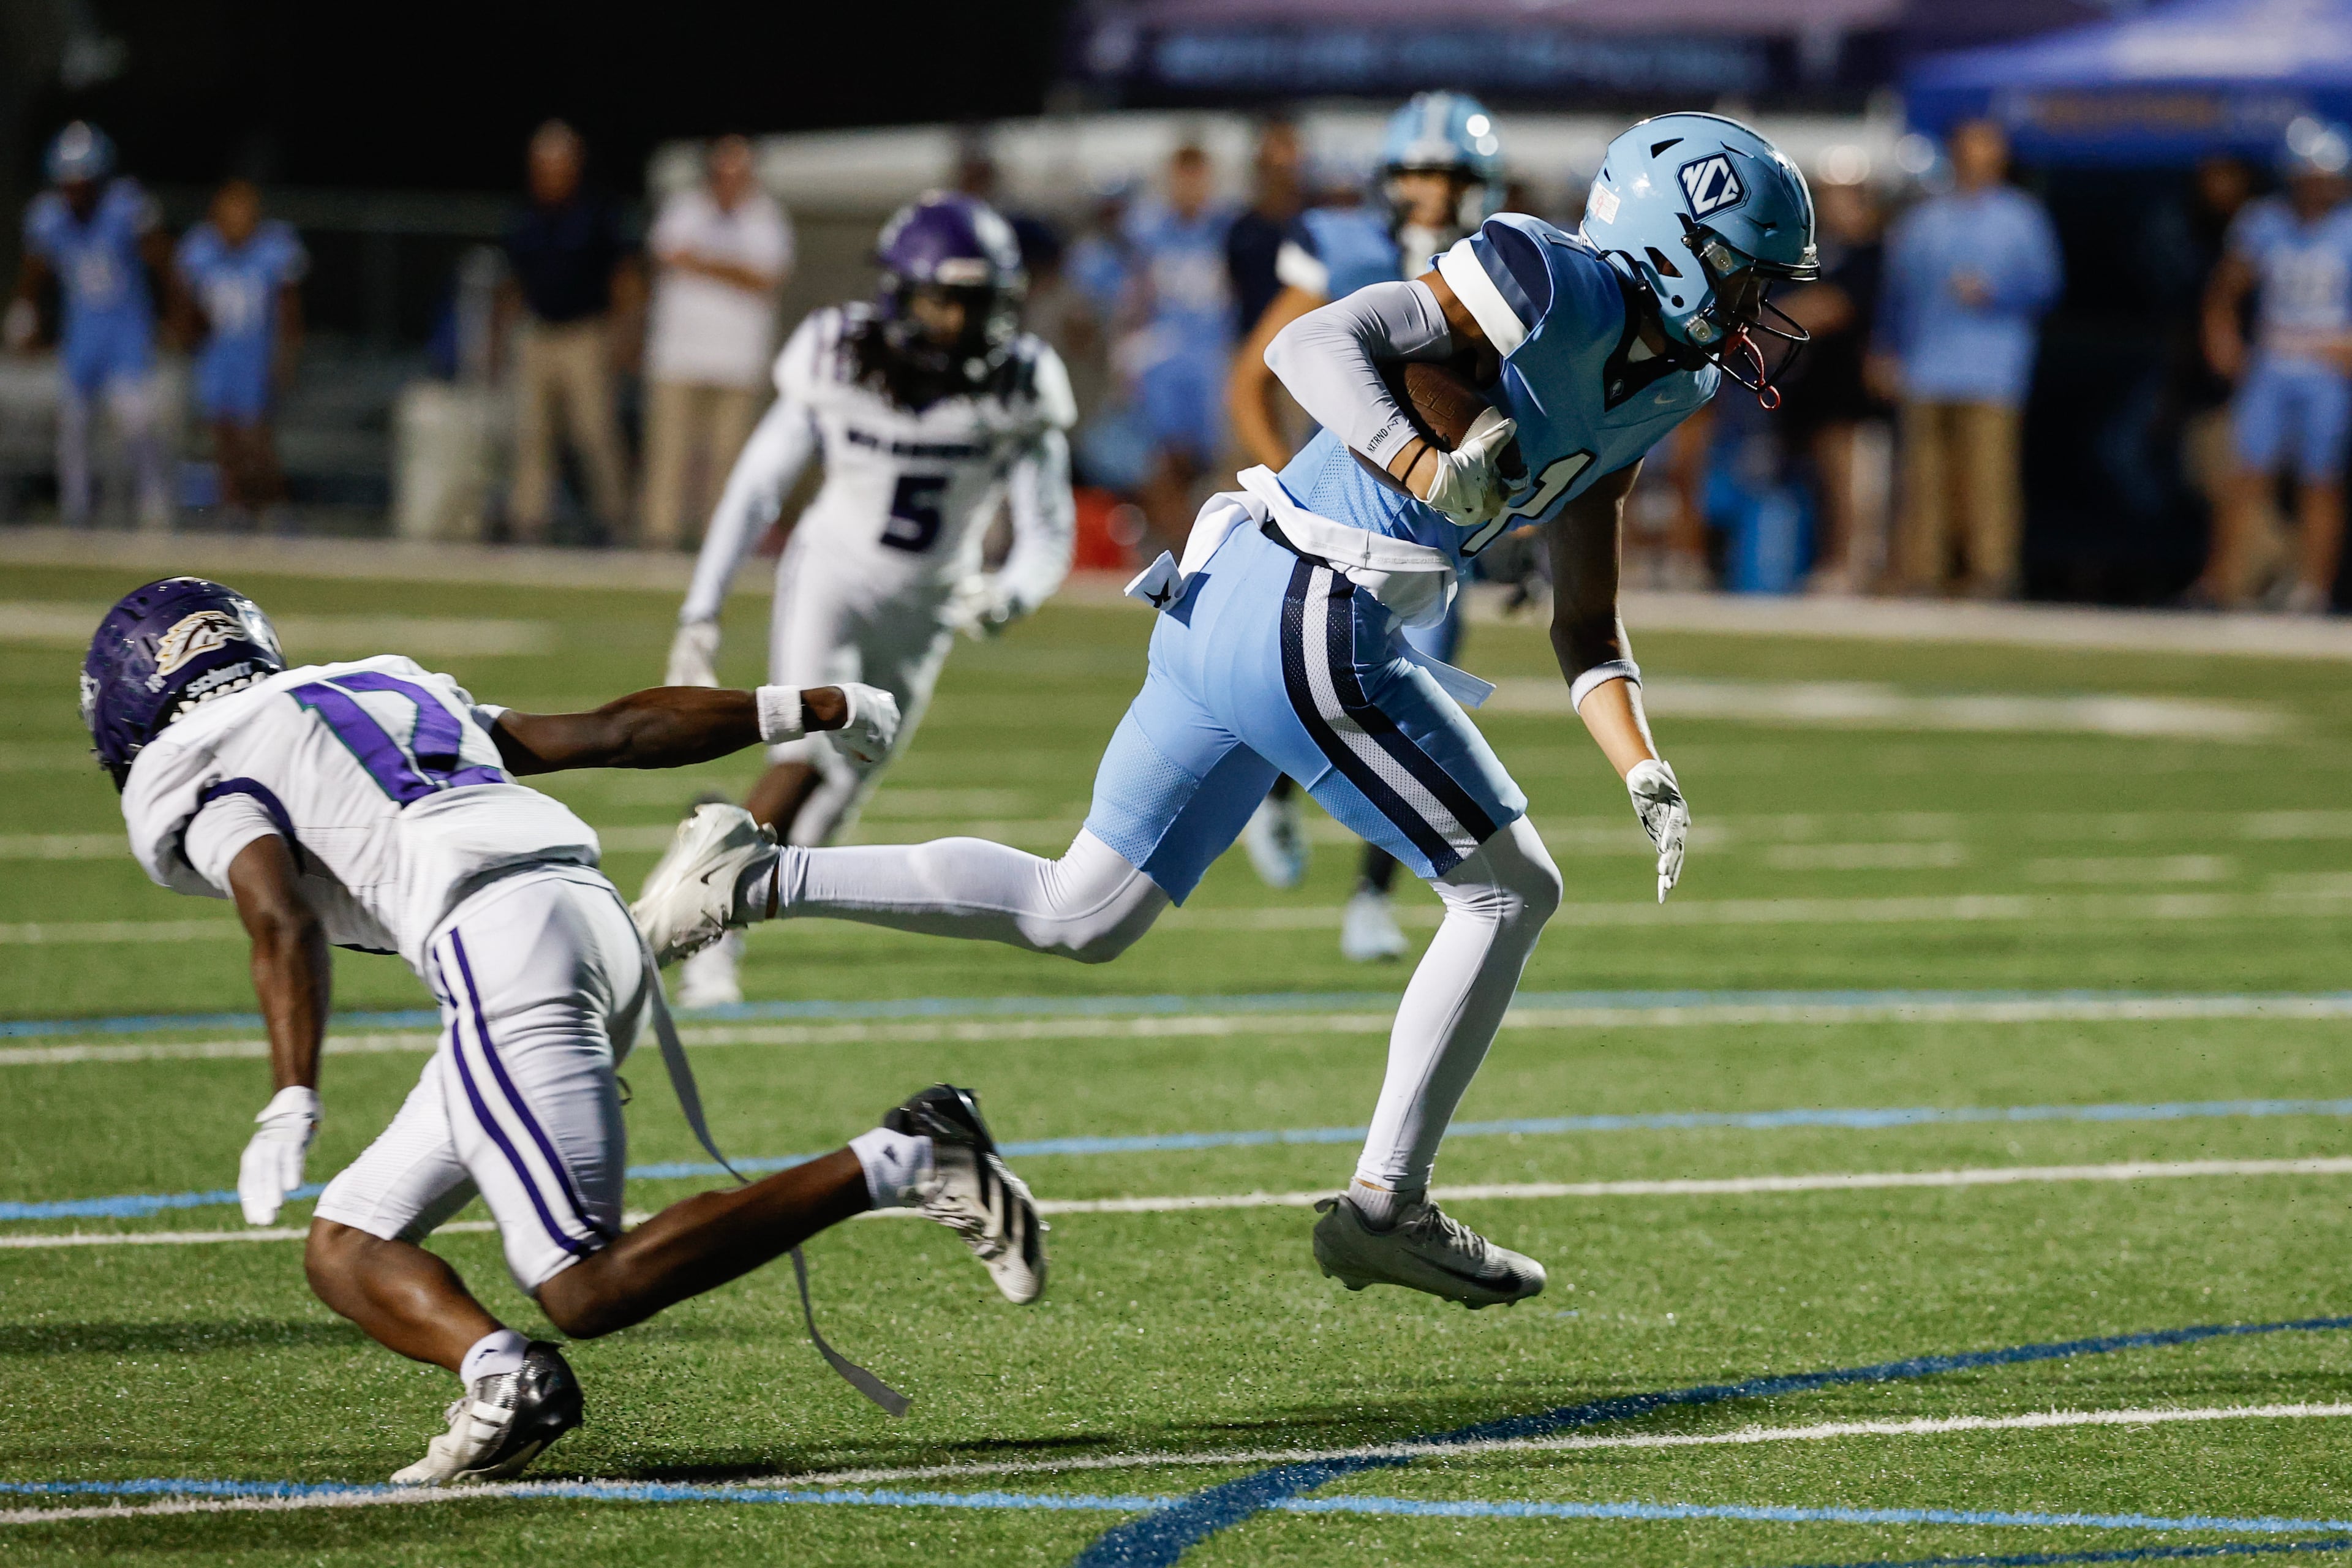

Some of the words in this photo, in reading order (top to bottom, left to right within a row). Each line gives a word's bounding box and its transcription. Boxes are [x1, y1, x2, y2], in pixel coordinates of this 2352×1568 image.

[1366, 428, 1389, 454] NXTRND
[878, 475, 948, 552] 5
[285, 671, 507, 809] 12
